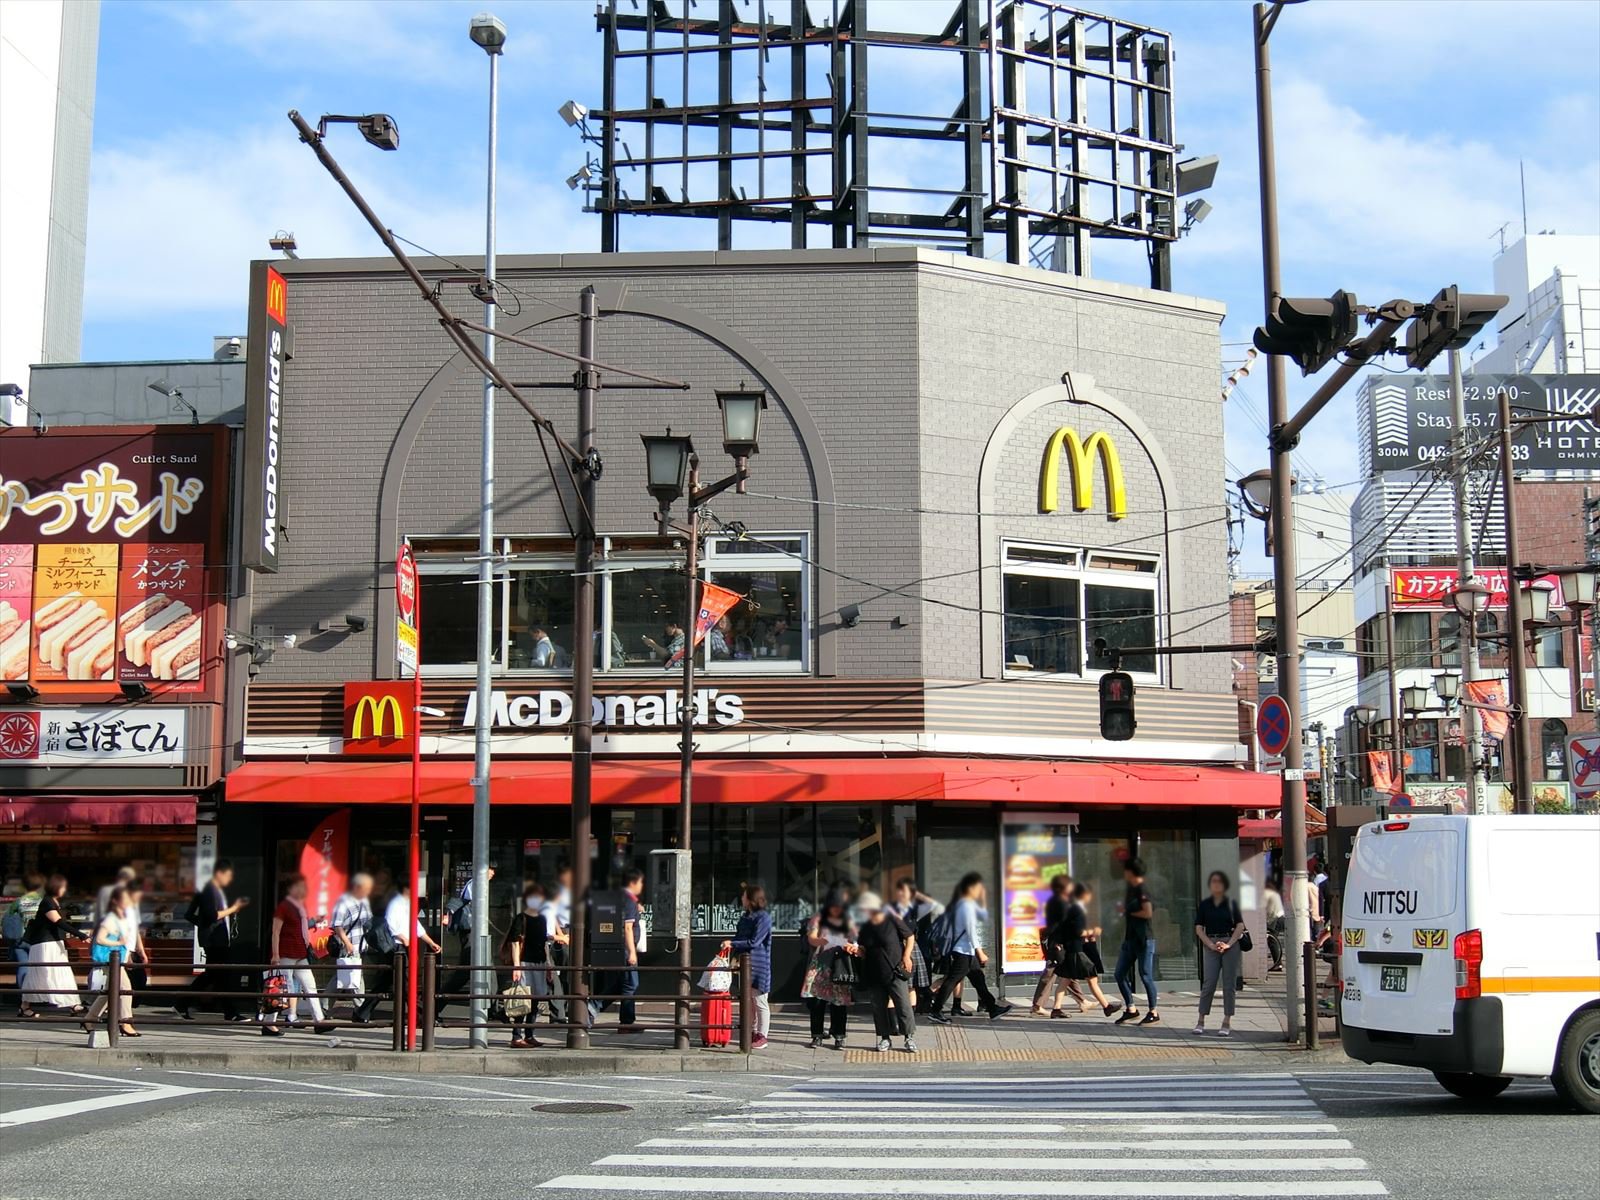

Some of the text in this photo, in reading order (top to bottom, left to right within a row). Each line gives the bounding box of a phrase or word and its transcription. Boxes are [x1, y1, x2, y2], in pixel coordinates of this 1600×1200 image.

[1415, 386, 1451, 401] Rest
[1416, 411, 1453, 429] Stay
[264, 329, 282, 556] McDonald's
[132, 454, 197, 464] Cutlet Sand
[1377, 448, 1409, 457] 300M
[58, 555, 96, 568] チーズ
[131, 559, 190, 579] メンチ
[46, 567, 107, 579] ミルフィーユ
[53, 580, 101, 590] かつサンド
[137, 580, 187, 590] かつサンド
[47, 721, 60, 752] 新宿
[65, 719, 179, 752] さぼてん
[1363, 890, 1418, 915] NITTSU
